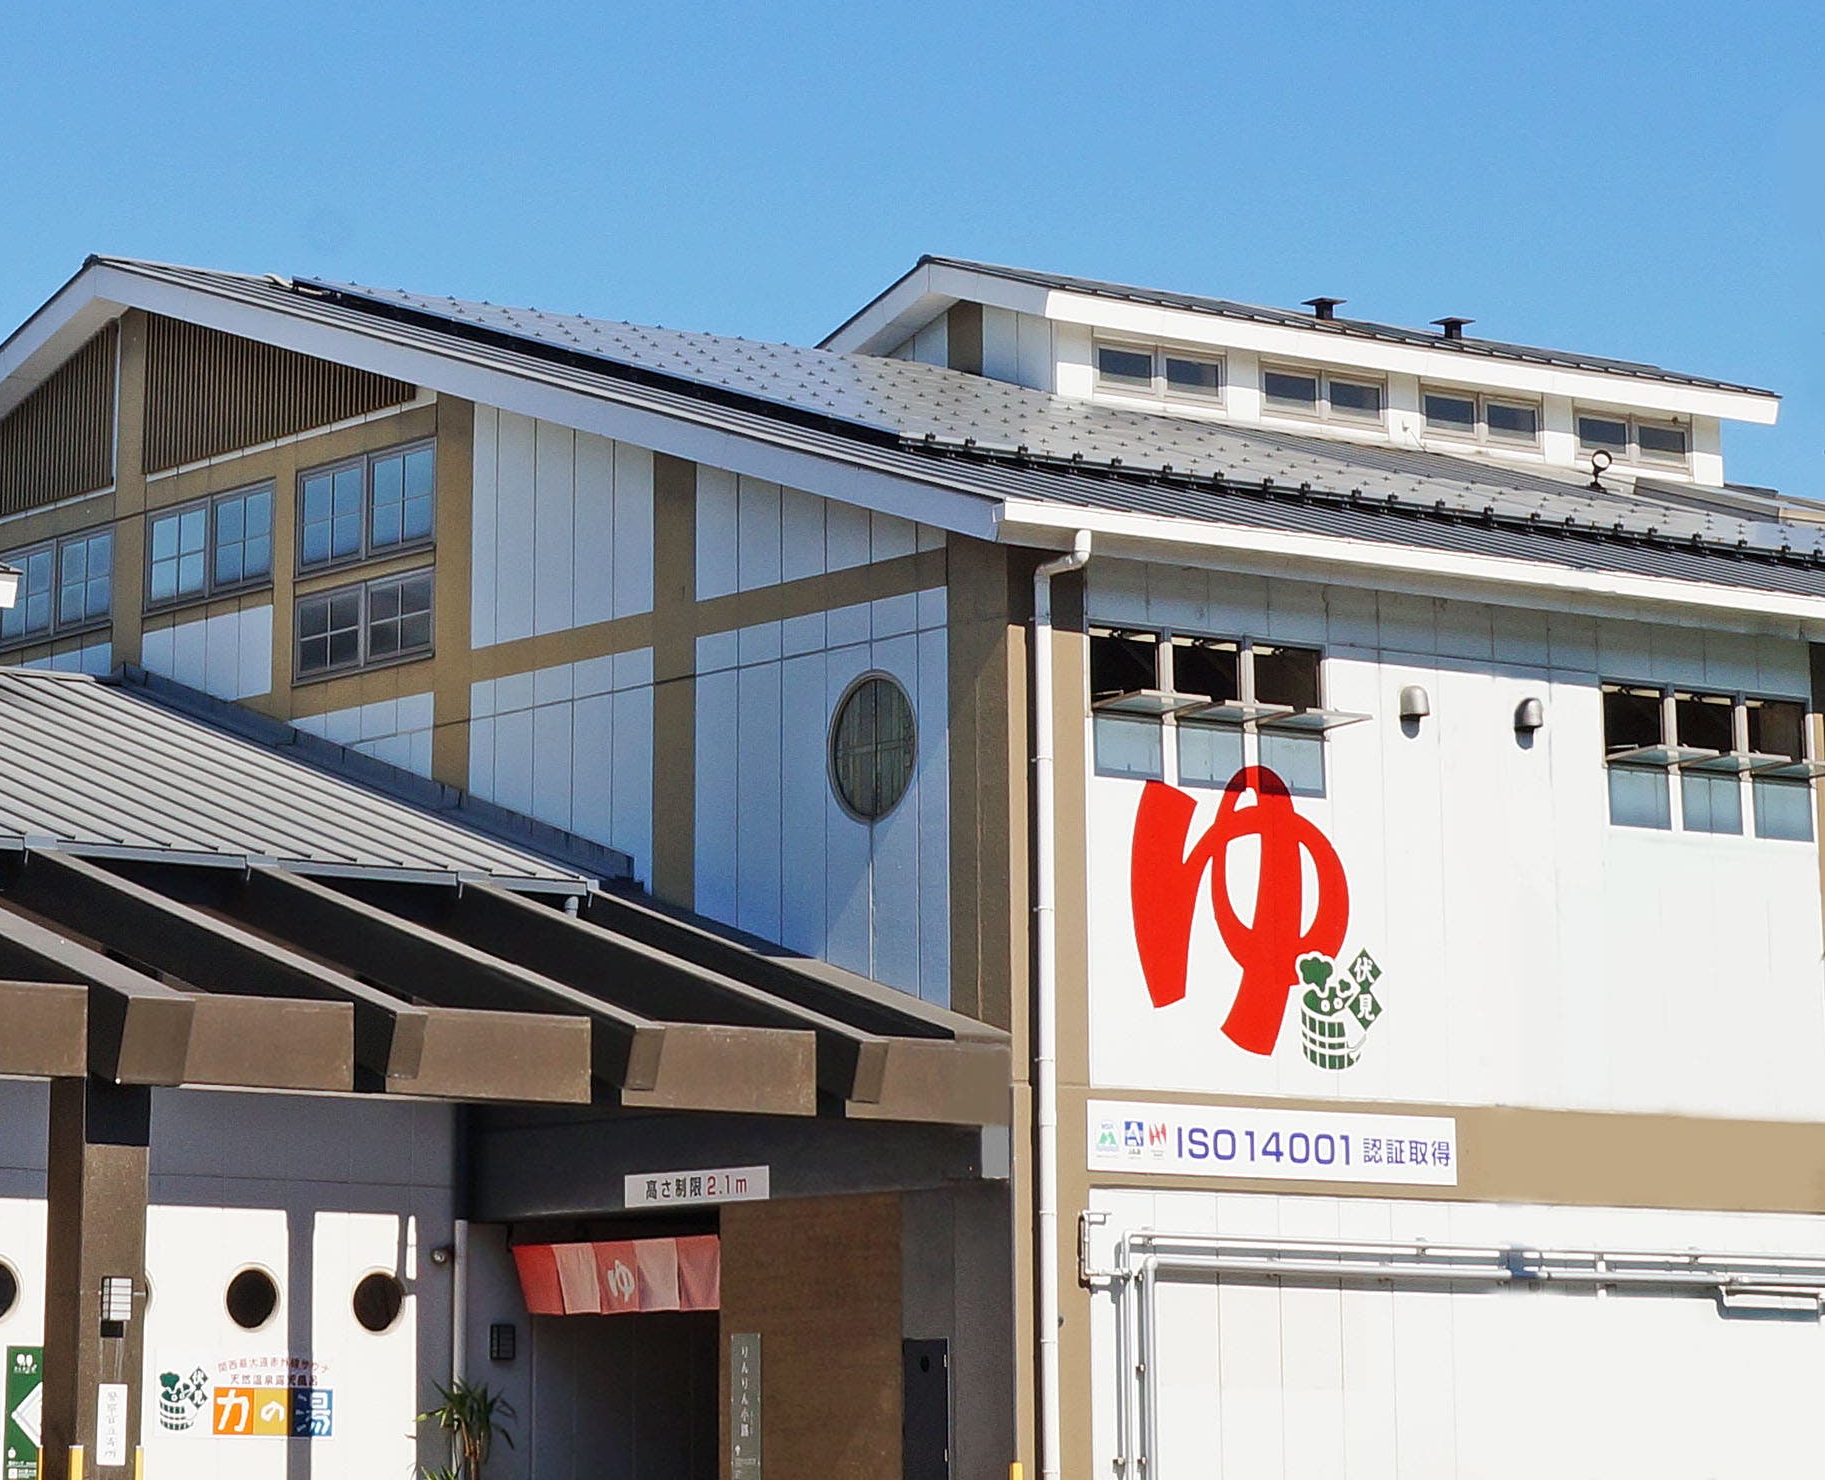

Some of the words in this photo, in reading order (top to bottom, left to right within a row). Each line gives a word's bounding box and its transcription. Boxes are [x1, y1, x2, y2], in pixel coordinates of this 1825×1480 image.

[1131, 766, 1349, 1056] ゆ
[1177, 1126, 1350, 1165] ISO14001
[1363, 1137, 1451, 1167] 認証取得
[607, 1259, 635, 1302] ゆ
[230, 1373, 318, 1387] 天然温泉露天風呂
[216, 1389, 331, 1433] 力の湯
